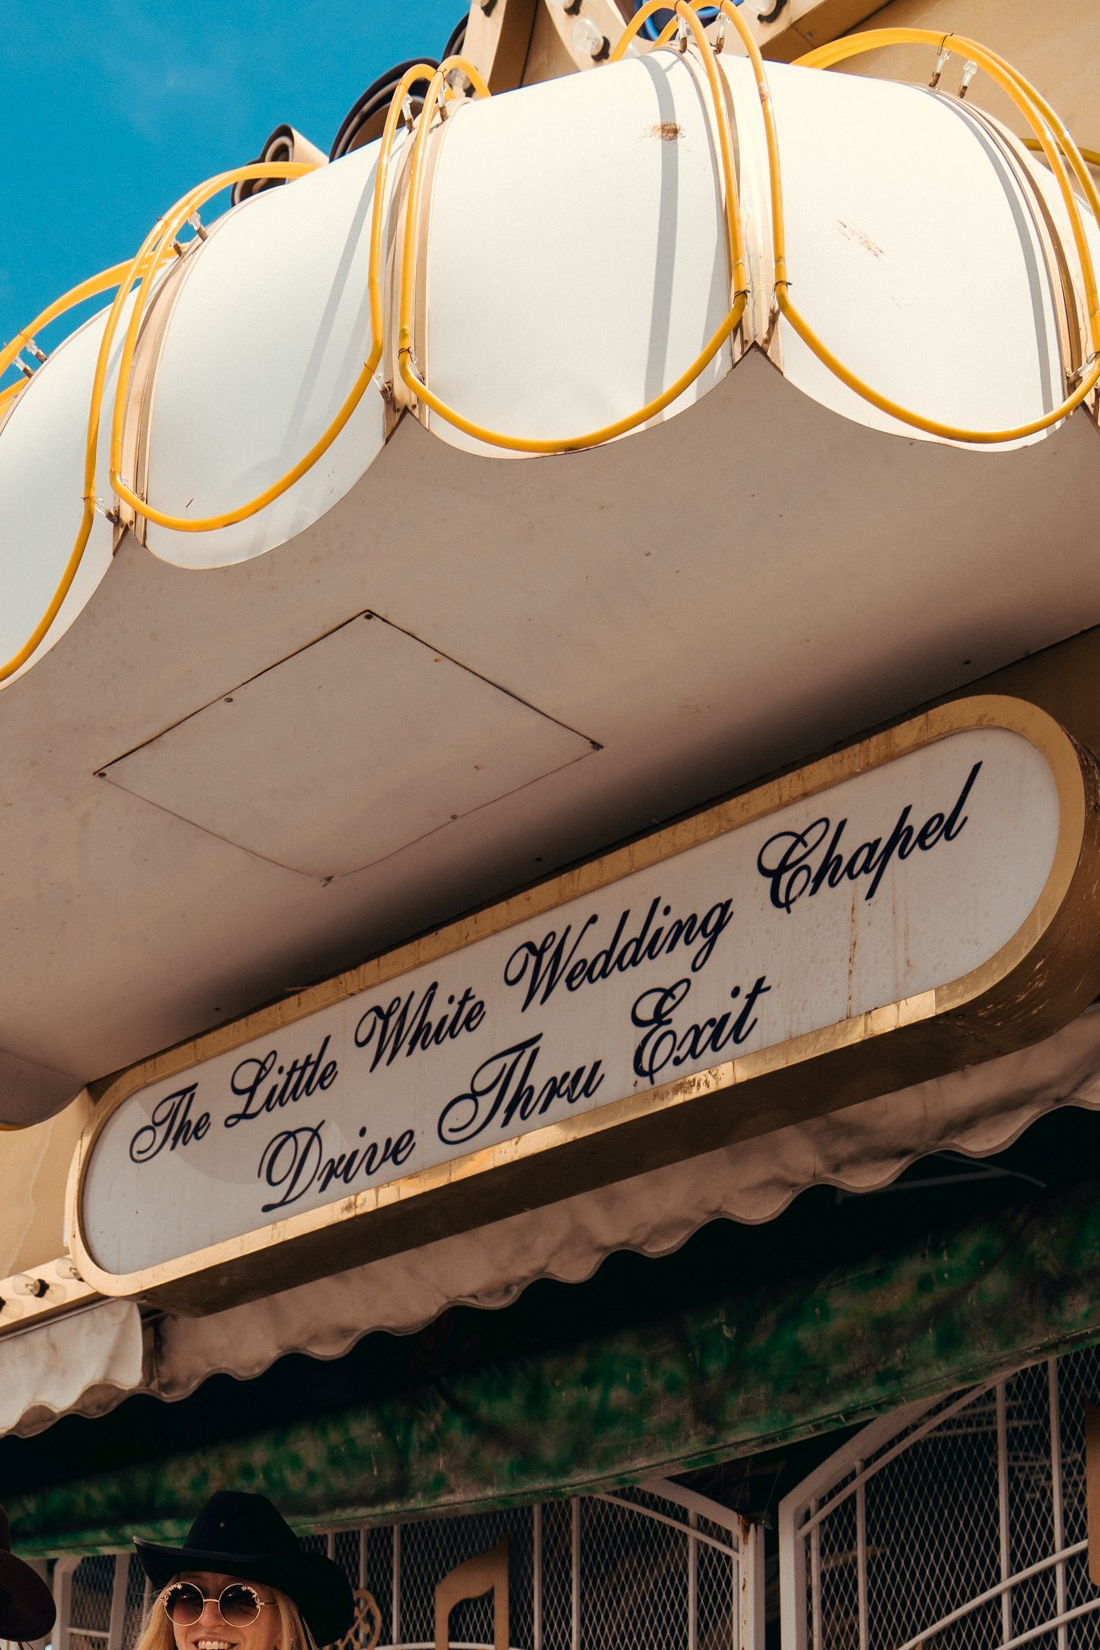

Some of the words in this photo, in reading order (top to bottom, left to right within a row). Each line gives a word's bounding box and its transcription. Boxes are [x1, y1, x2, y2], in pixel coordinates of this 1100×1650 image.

[128, 1081, 212, 1164] The
[223, 1034, 338, 1128] Little
[353, 981, 487, 1074] White
[503, 896, 735, 1013] Wedding
[756, 761, 984, 914] Chapel
[256, 1119, 417, 1213] Drive
[436, 1032, 604, 1146] Thru
[630, 976, 772, 1085] Exit
